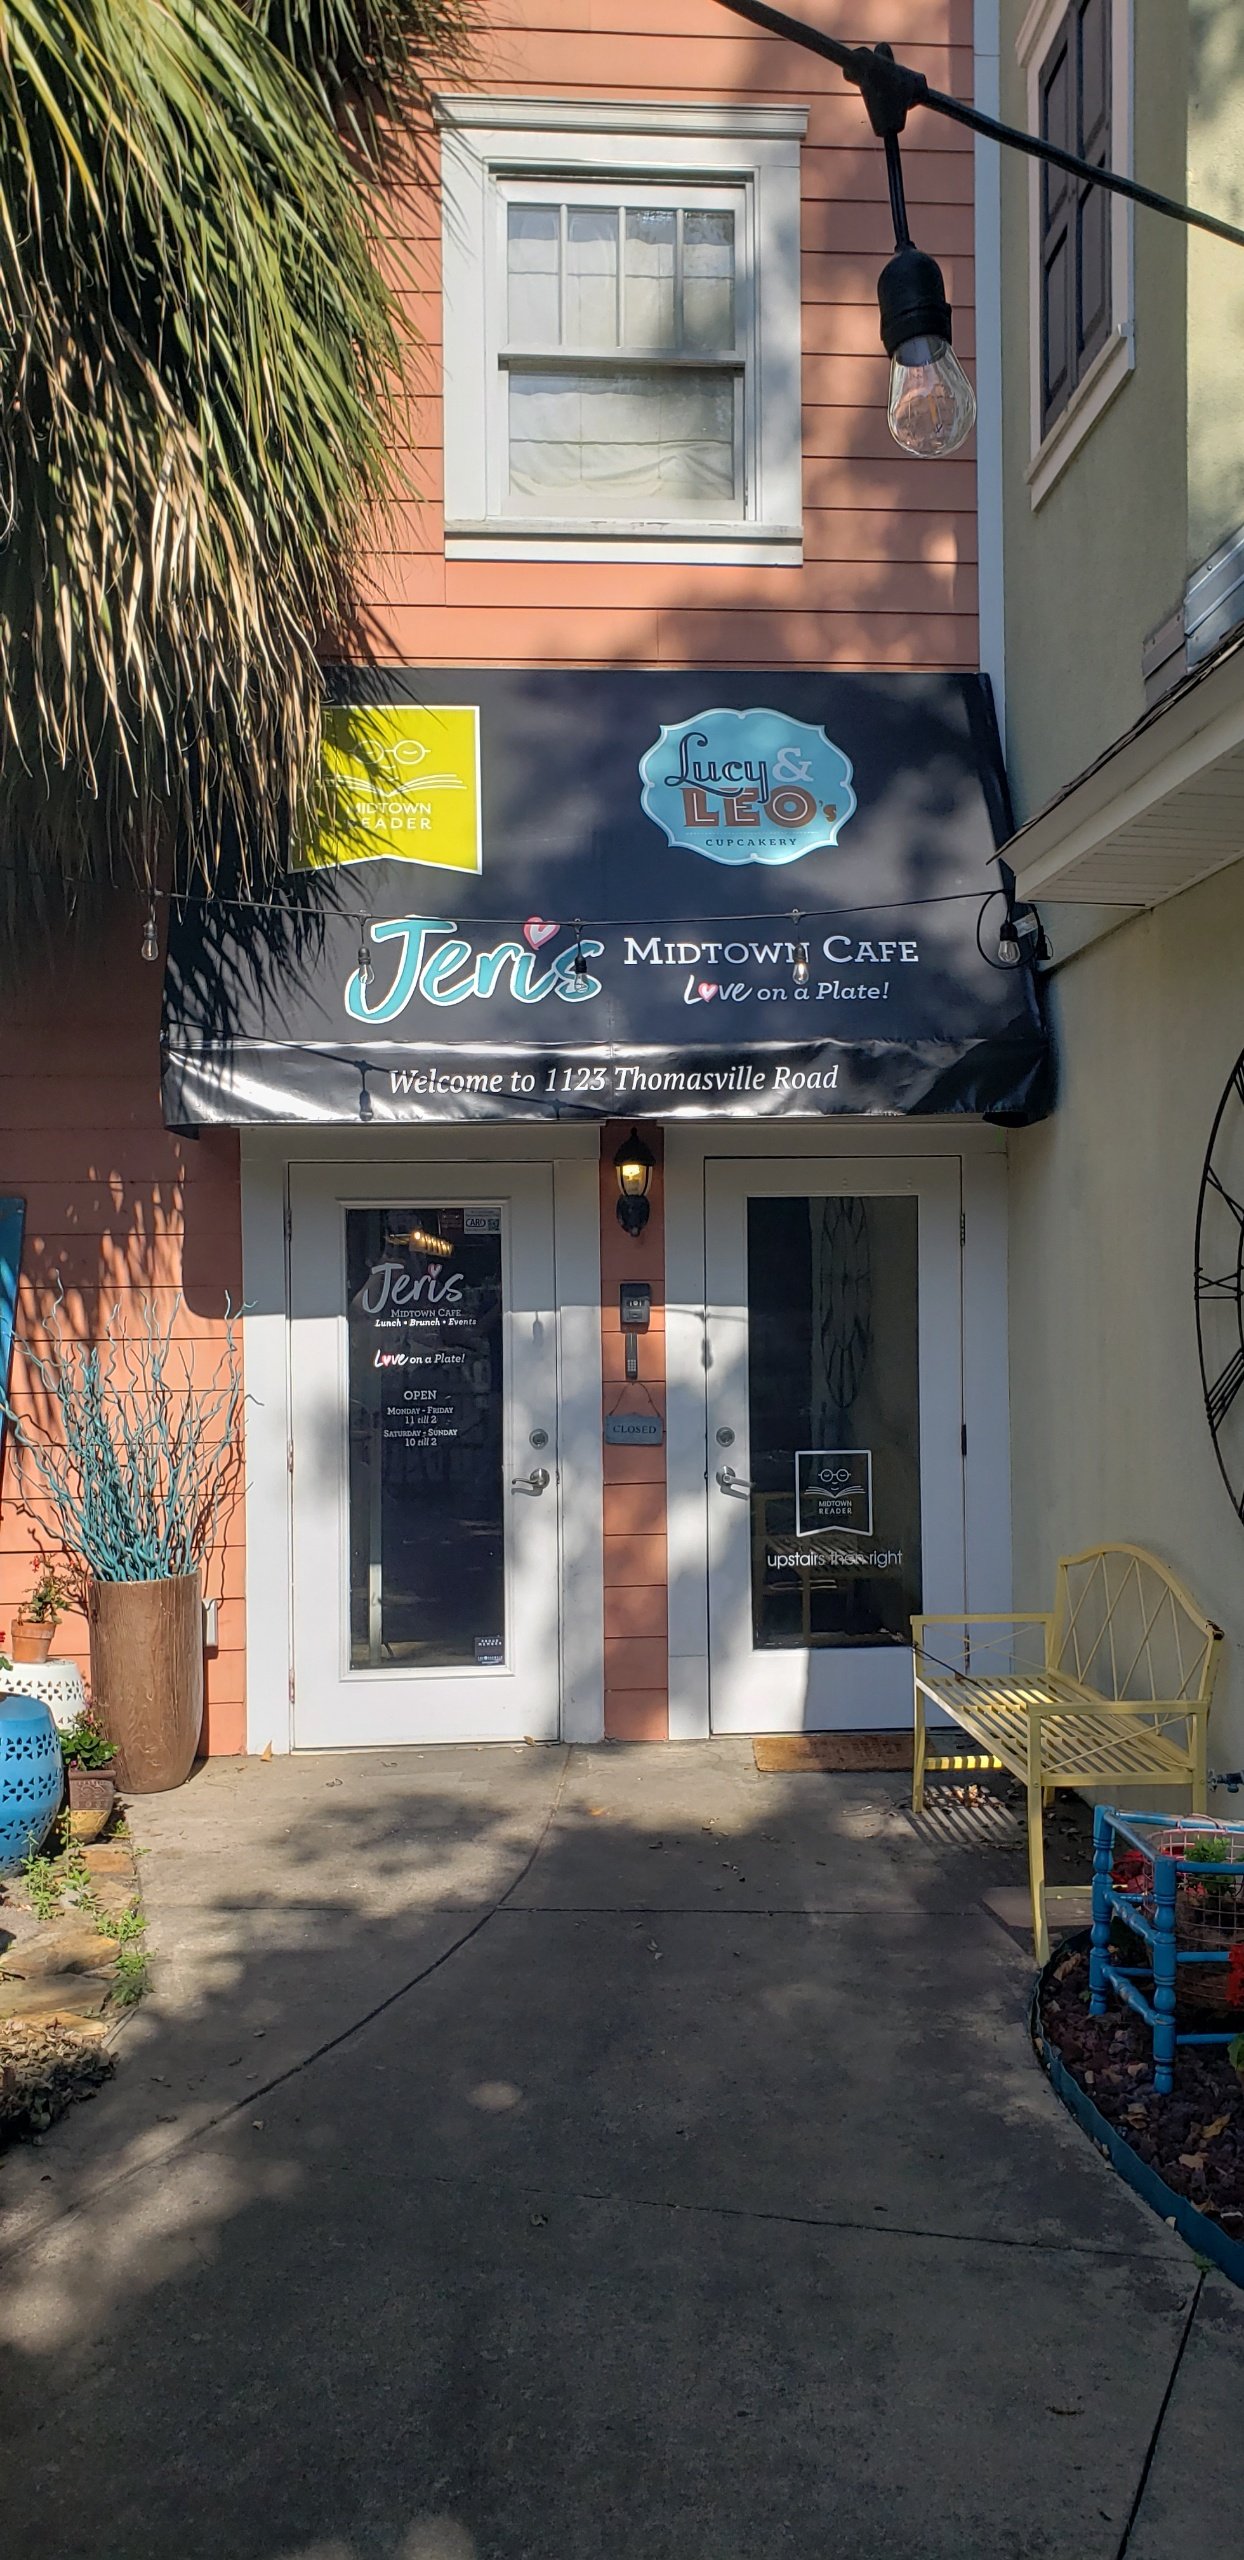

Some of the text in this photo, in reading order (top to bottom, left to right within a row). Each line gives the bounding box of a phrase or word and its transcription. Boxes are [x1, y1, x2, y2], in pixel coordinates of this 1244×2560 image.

[664, 732, 814, 804] Lucy &
[705, 838, 797, 847] CUPCAKERY
[623, 935, 919, 965] MIDTOWN CAFE
[344, 914, 605, 1025] Jeris
[757, 985, 788, 1001] on
[793, 986, 810, 1001] a
[815, 981, 890, 1001] Plate!
[389, 1064, 839, 1094] Welcome to 1123 Thomasville Road
[362, 1263, 465, 1314] Jeris
[390, 1308, 462, 1318] MIDTOWN CAFE
[374, 1317, 477, 1327] Lunch Brunch Events
[409, 1356, 423, 1364] on
[424, 1356, 432, 1364] a
[434, 1353, 466, 1364] Plate!
[403, 1390, 437, 1400] OPEN
[387, 1406, 420, 1415] MONDAY
[427, 1406, 454, 1414] FRIDAY
[405, 1415, 437, 1424] 11 till 2
[383, 1429, 421, 1438] SATURDAY
[427, 1428, 458, 1436] SUNDAY
[613, 1424, 657, 1434] CLOSED
[405, 1438, 437, 1447] 10 till 2
[767, 1550, 903, 1569] upstairs then right
